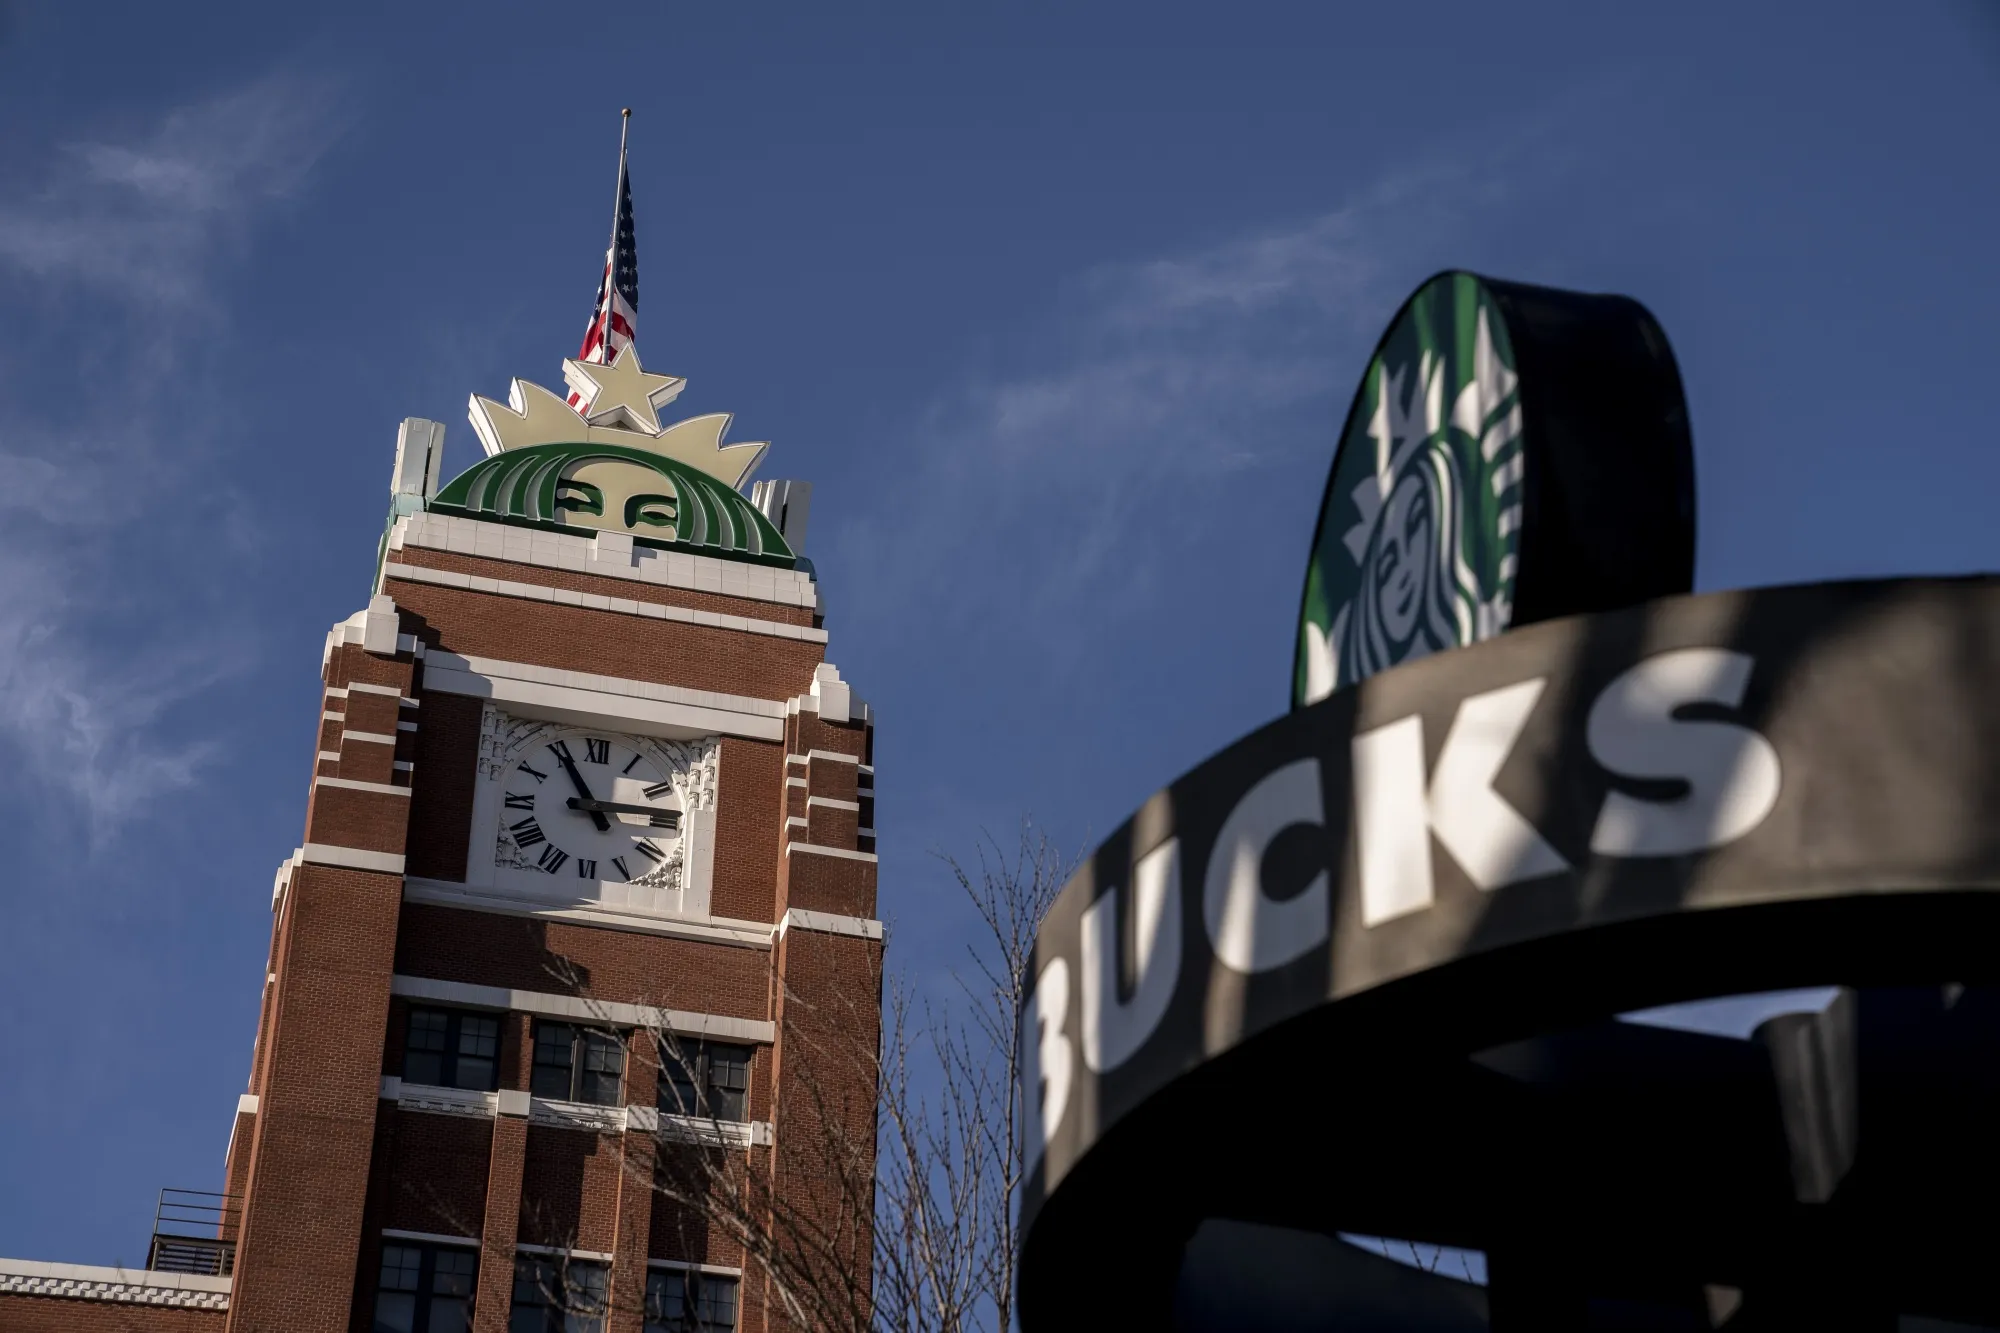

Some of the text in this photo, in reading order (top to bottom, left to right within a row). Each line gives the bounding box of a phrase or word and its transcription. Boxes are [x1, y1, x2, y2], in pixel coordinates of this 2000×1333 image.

[545, 740, 575, 768] XI
[584, 738, 611, 764] XII
[517, 760, 548, 784] X
[622, 753, 642, 774] I
[505, 791, 534, 811] IX
[642, 781, 672, 799] II
[509, 815, 546, 849] VIII
[538, 842, 570, 874] VII
[578, 858, 597, 879] VI
[611, 856, 631, 881] V
